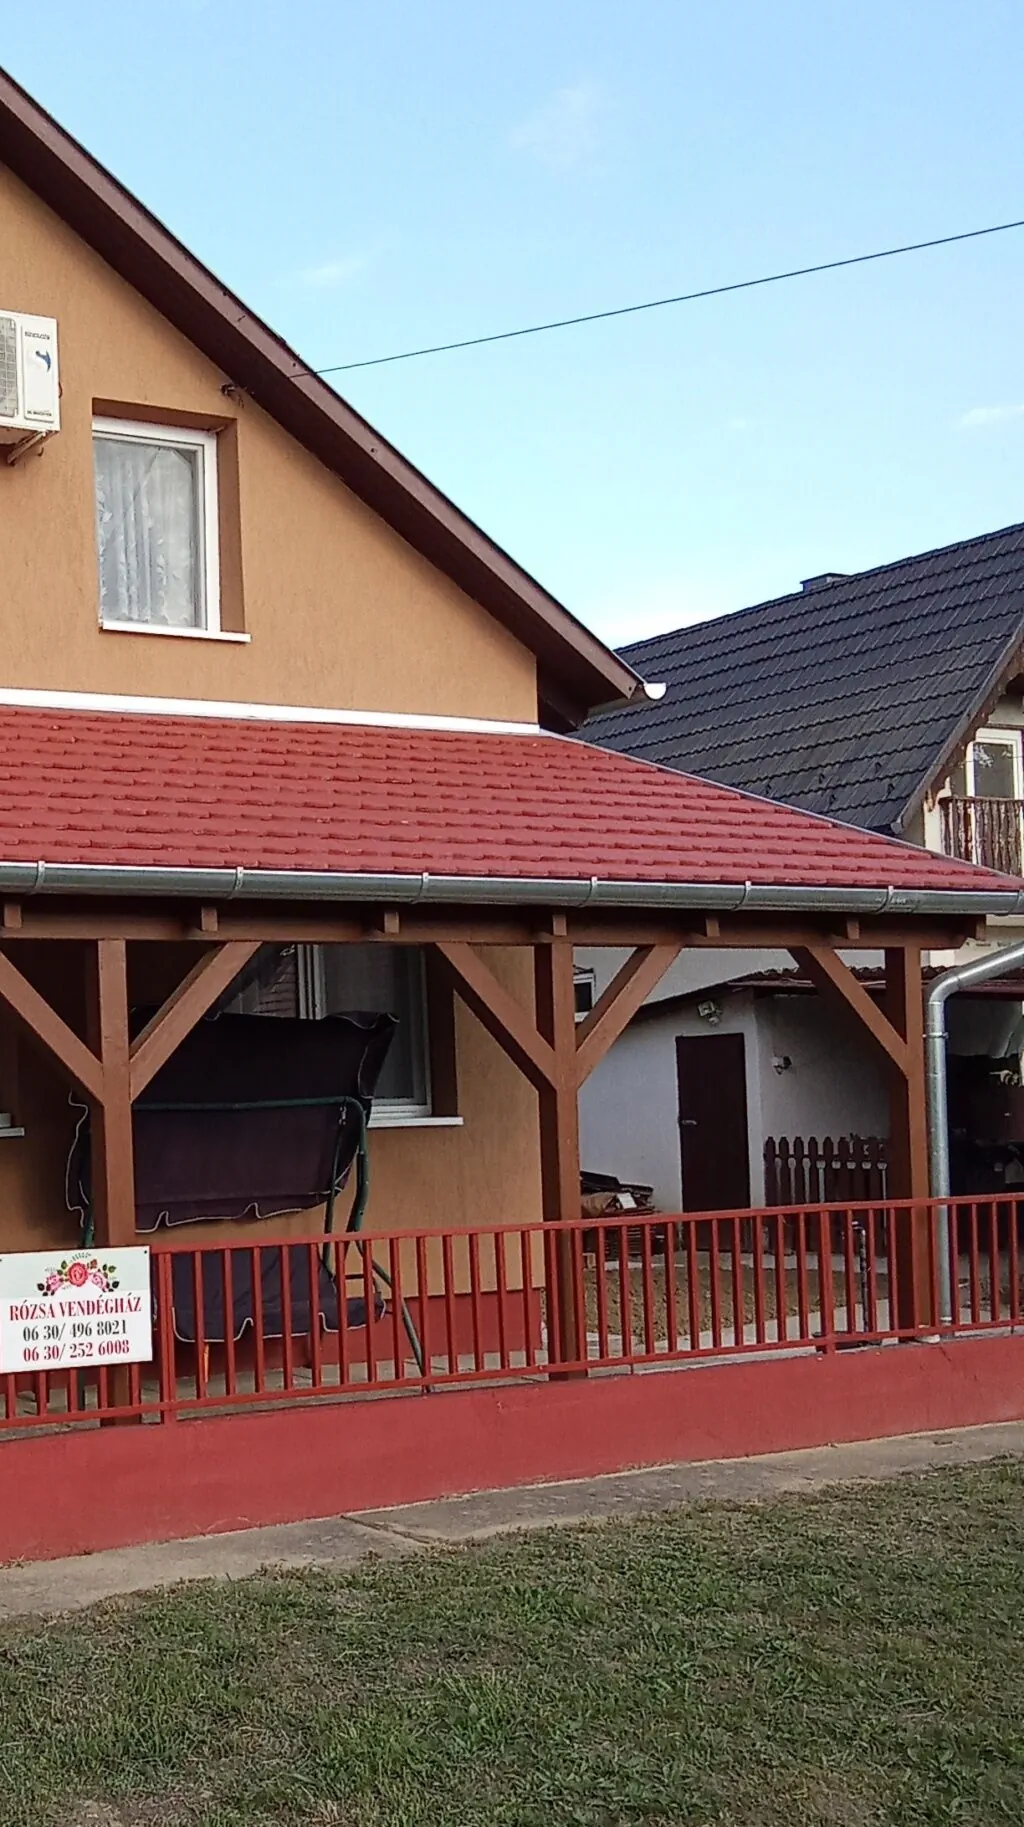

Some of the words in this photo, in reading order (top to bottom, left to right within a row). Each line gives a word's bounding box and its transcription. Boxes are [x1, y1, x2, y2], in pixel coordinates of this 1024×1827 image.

[10, 1299, 55, 1321] RÓZSA
[59, 1292, 142, 1317] VENDÉGHÁZ
[23, 1326, 39, 1341] 06
[44, 1323, 66, 1341] 30/
[70, 1321, 92, 1338] 496
[97, 1319, 127, 1336] 8021
[23, 1346, 39, 1362] 06
[44, 1343, 66, 1361] 30/
[69, 1342, 93, 1358] 252
[98, 1339, 130, 1356] 6008
